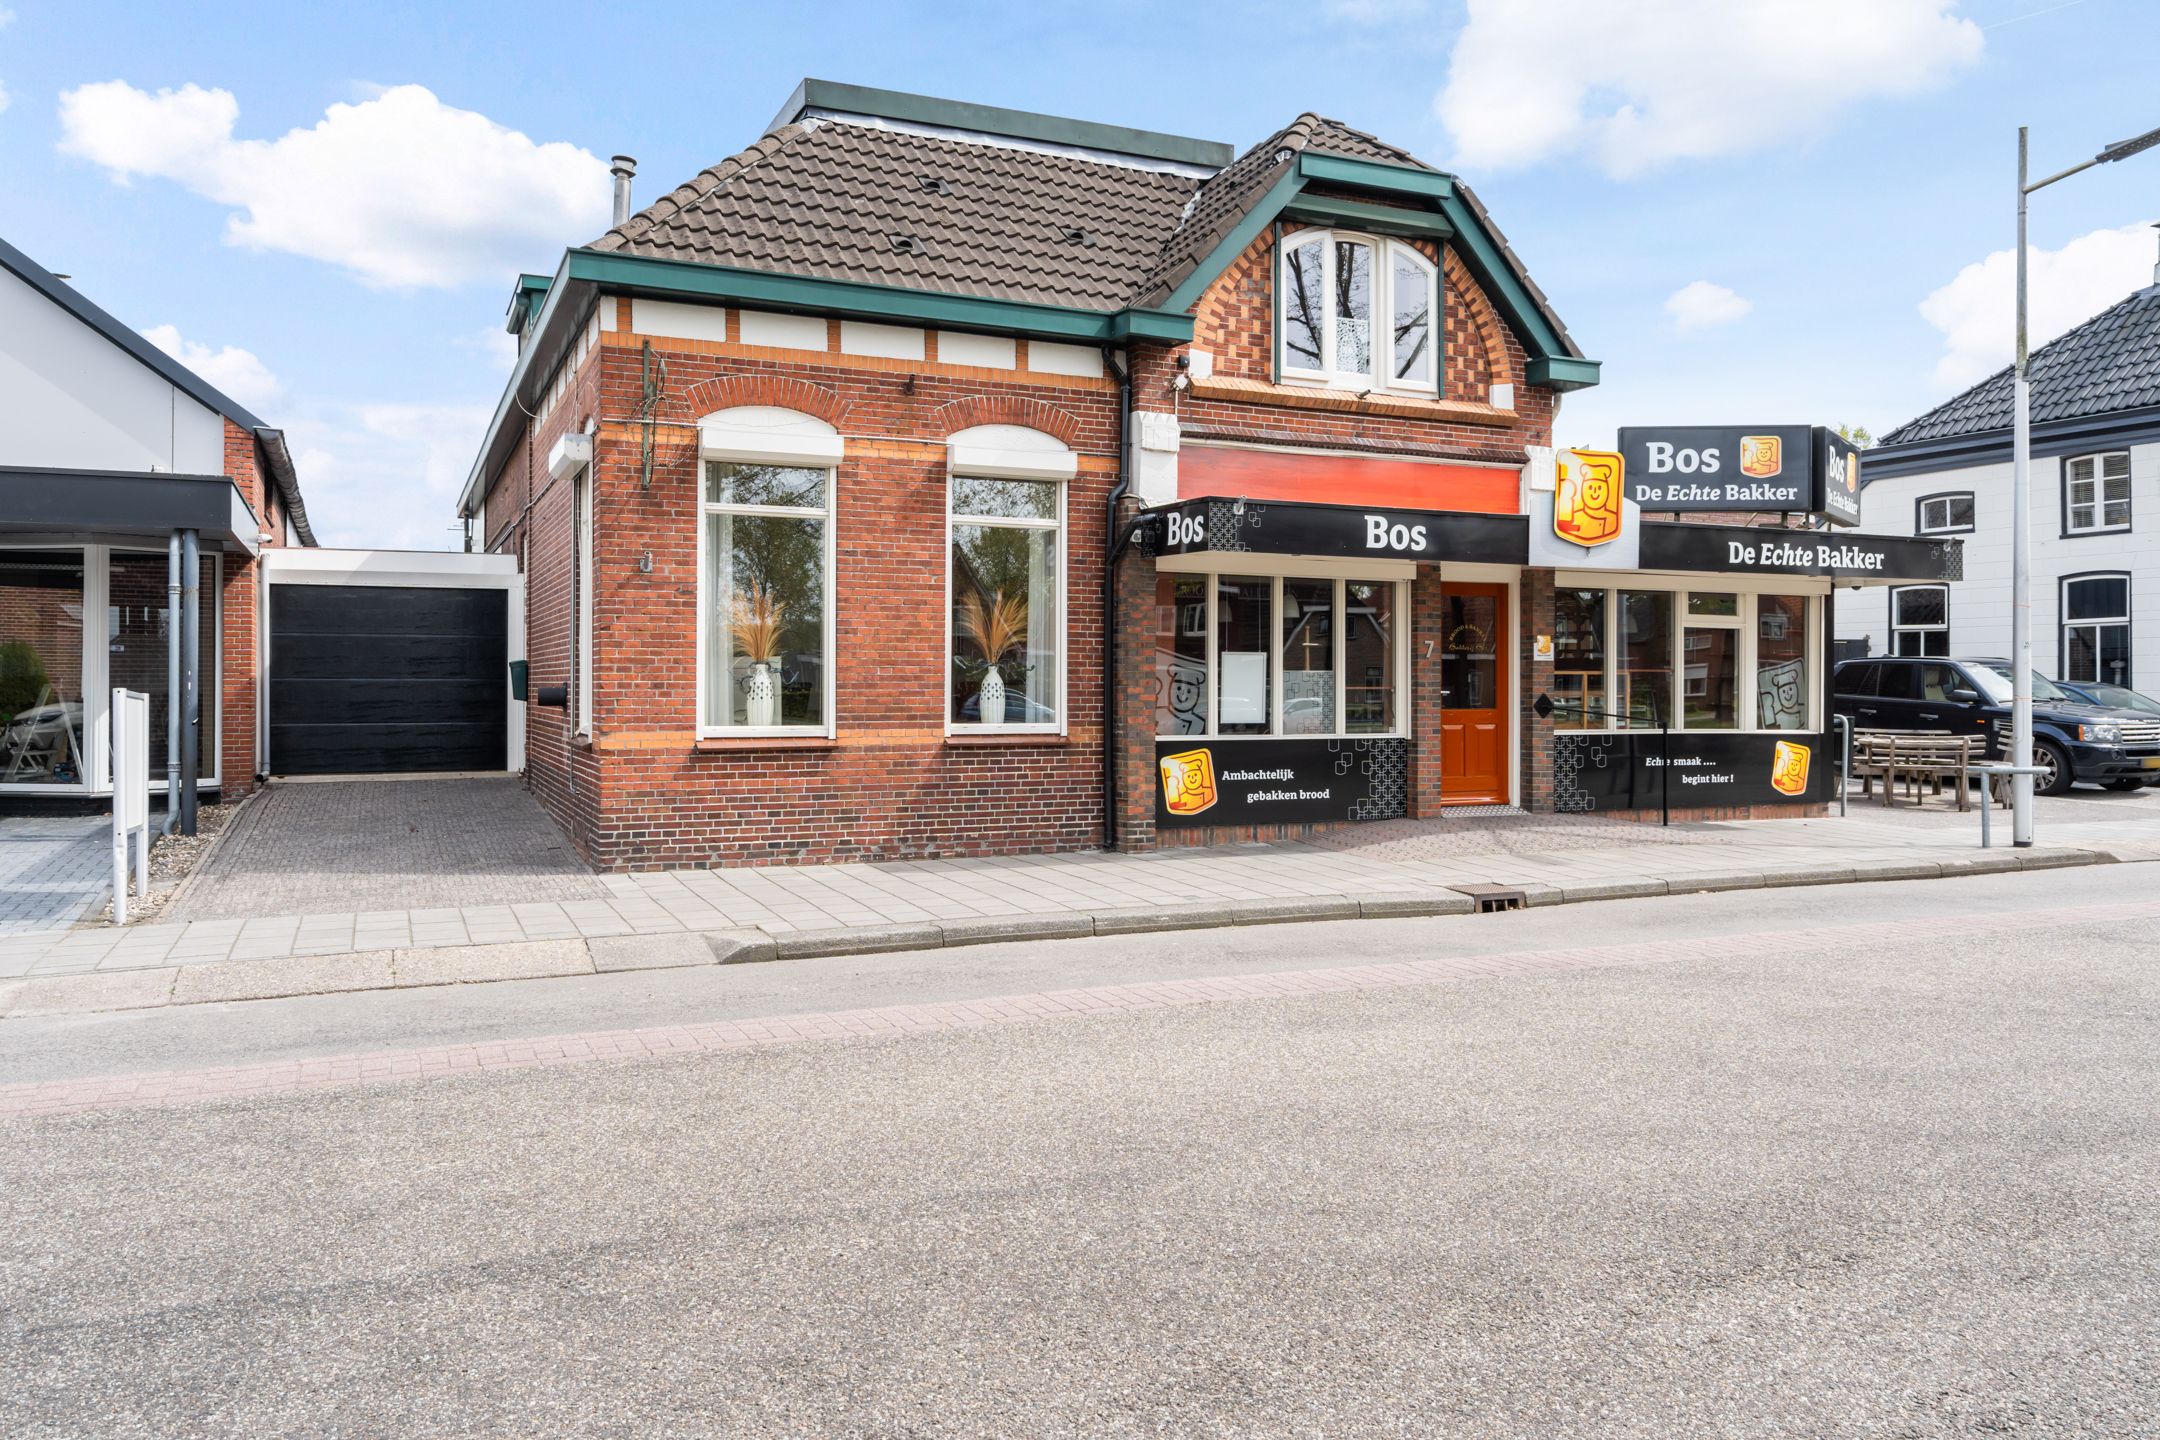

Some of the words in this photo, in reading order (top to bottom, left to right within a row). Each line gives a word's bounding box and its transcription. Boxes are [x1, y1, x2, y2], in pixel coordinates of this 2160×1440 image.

[1646, 441, 1721, 474] Bos
[1829, 445, 1844, 483] Bos
[1636, 485, 1663, 501] De
[1666, 484, 1721, 501] Echte
[1725, 484, 1798, 501] Bakker
[1827, 487, 1834, 505] De
[1833, 490, 1845, 509] Echte
[1844, 496, 1858, 515] Bakker
[1167, 512, 1204, 546] Bos
[1364, 515, 1427, 552] Bos
[1728, 541, 1756, 565] De
[1760, 543, 1813, 567] Echte
[1817, 545, 1884, 570] Bakker
[1424, 640, 1435, 658] 7
[1222, 769, 1295, 781] Ambachtelijk
[1682, 774, 1710, 785] begint
[1711, 774, 1729, 783] hier
[1247, 790, 1298, 803] gebakken
[1299, 789, 1330, 800] brood
